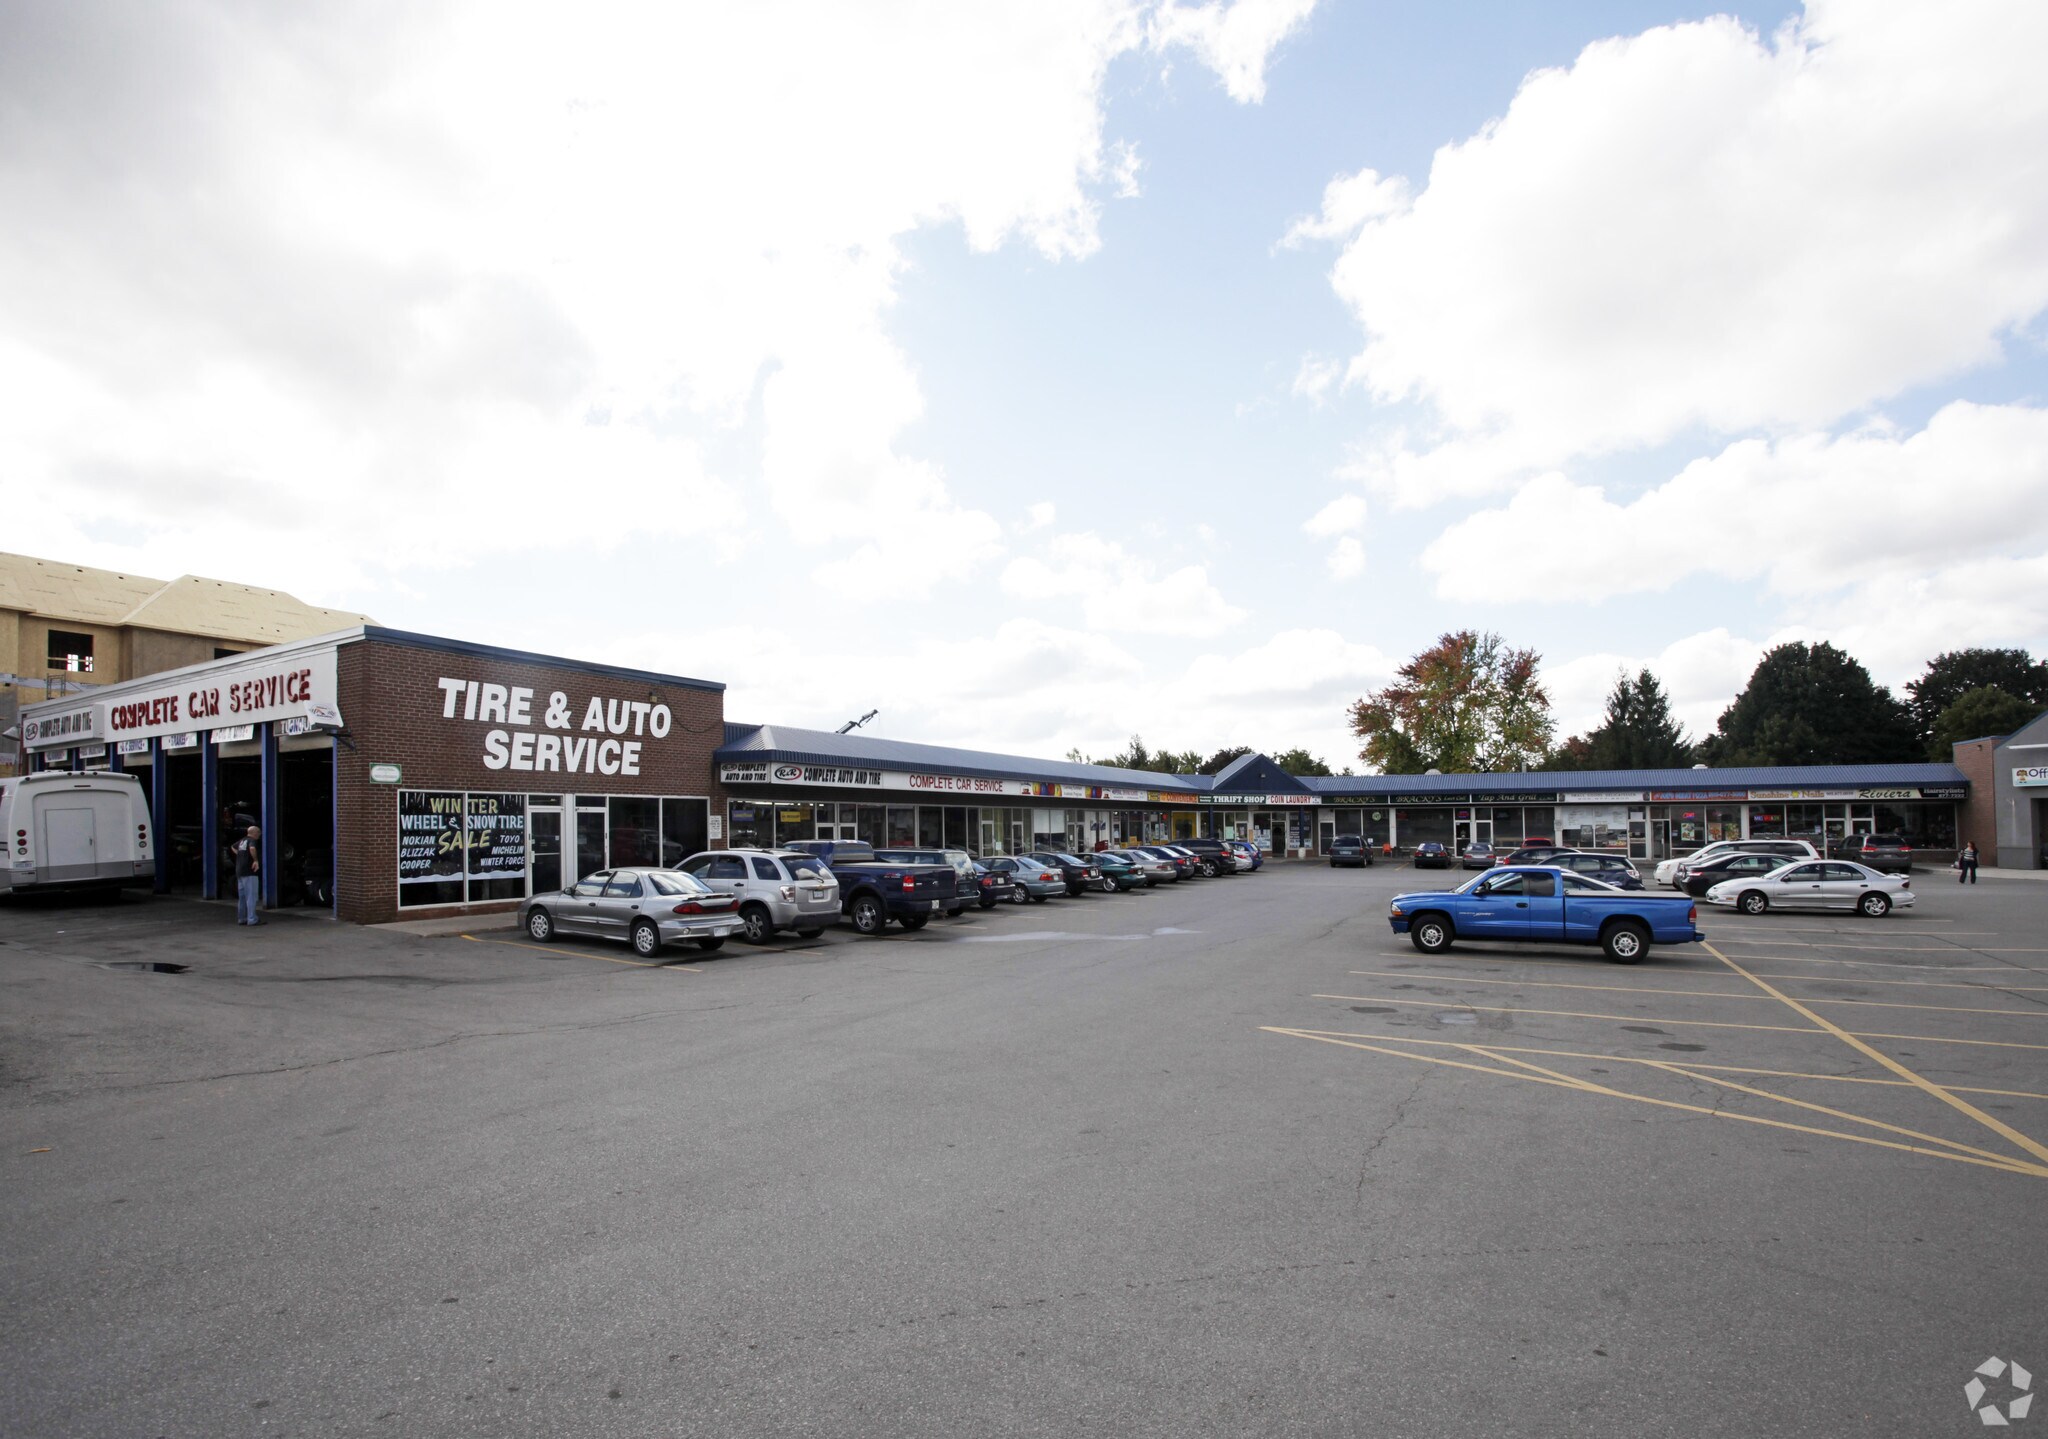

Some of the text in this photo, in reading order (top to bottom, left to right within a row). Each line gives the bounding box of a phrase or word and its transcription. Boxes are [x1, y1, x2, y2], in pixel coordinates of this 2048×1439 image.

[111, 669, 311, 731] COMPLETE CAR SERVICE
[438, 677, 672, 739] TIRE & AUTO
[40, 717, 60, 739] COMPLETE
[72, 713, 81, 733] AND
[482, 729, 642, 776] SERVICE
[737, 763, 767, 772] COMPLETE
[725, 772, 767, 781] AUTO AND TIRE
[803, 767, 836, 783] COMPLETE
[838, 770, 854, 784] AUTO
[855, 771, 868, 785] AND
[869, 772, 881, 786] TIRE
[909, 774, 1003, 792] COMPLETE CAR SERVICE
[1213, 795, 1242, 803] THRIFT
[1243, 795, 1265, 803] SHOP
[1518, 794, 1537, 802] Grill
[1750, 790, 1790, 799] Sunshine
[1801, 790, 1825, 798] Nails
[1859, 788, 1912, 799] Riviera
[1270, 795, 1285, 804] COIN
[1286, 795, 1312, 804] LAUNDRY
[430, 797, 499, 814] WINTER
[400, 814, 524, 830] WHEEL & SNOW TIRE
[402, 835, 436, 846] NOKIAN
[438, 829, 492, 855] SALE
[500, 835, 520, 844] TOYO
[400, 847, 436, 858] BLIZZAK
[491, 845, 525, 855] MICHELIN
[400, 859, 431, 870] COOPER
[480, 856, 525, 867] WINTER FORCE
